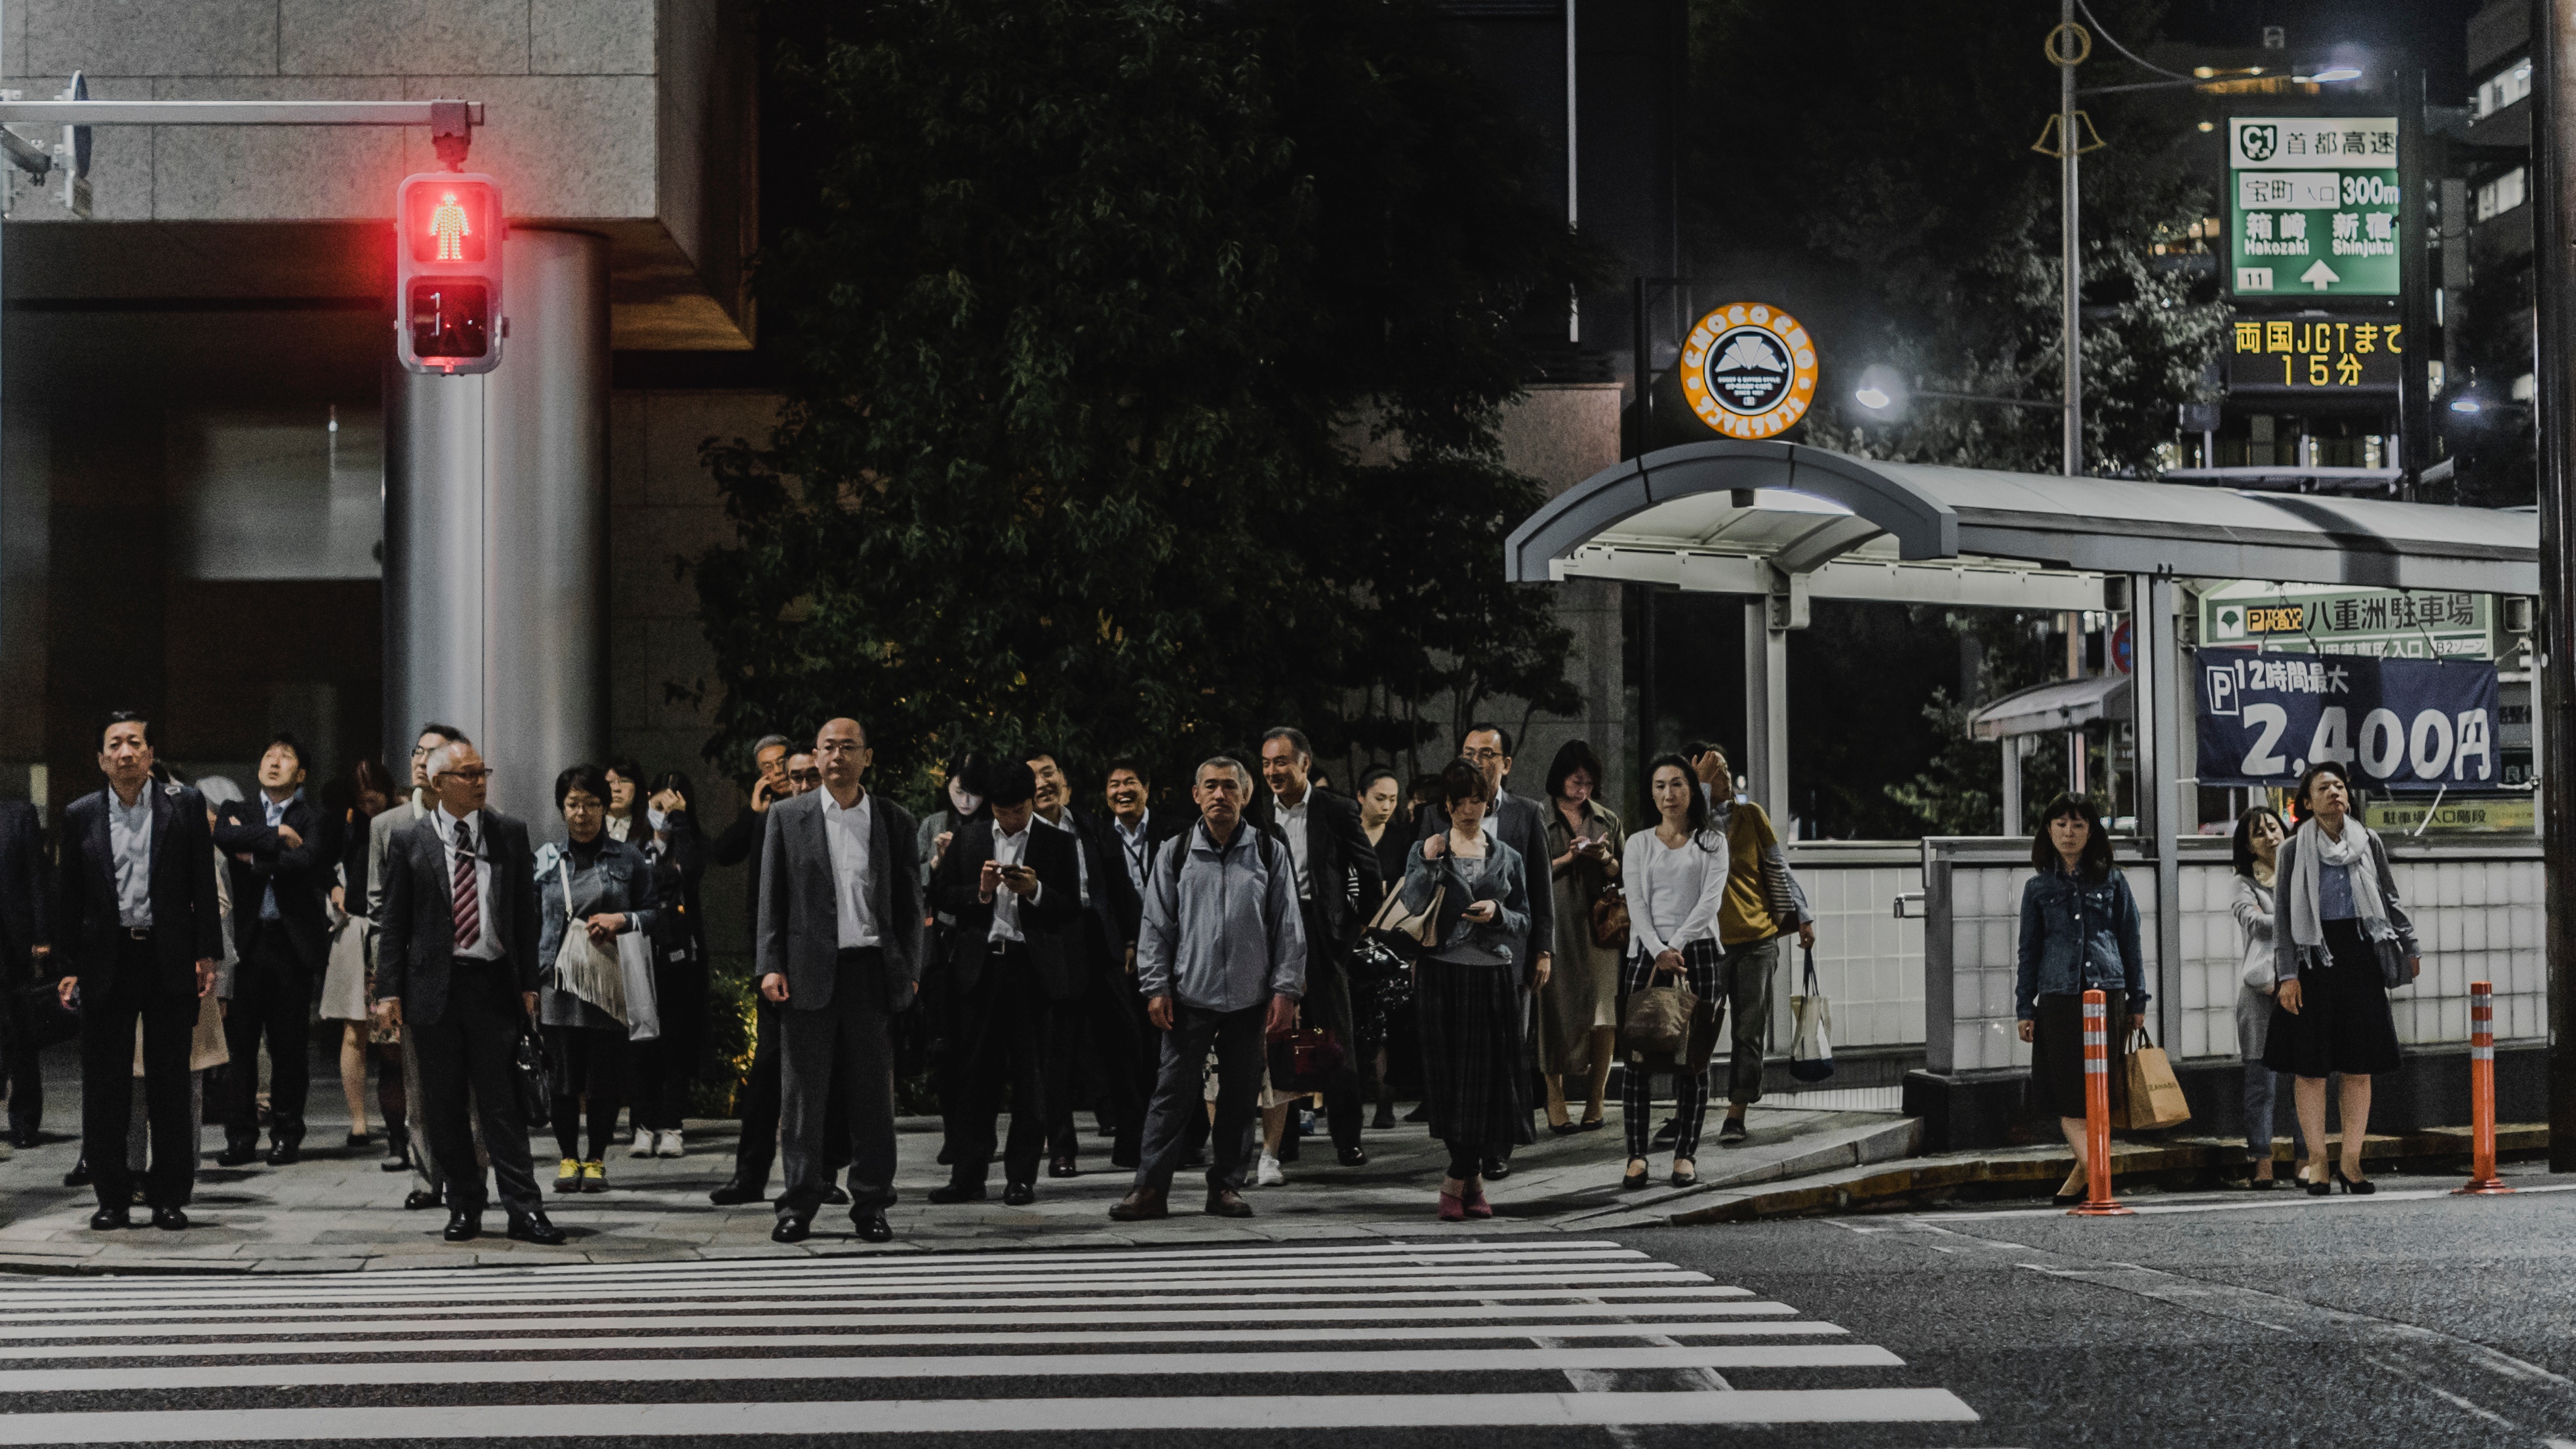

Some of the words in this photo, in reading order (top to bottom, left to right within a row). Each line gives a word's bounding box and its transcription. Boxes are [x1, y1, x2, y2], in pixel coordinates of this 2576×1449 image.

[2242, 126, 2274, 150] C1
[2286, 131, 2396, 155] 首都高速
[2246, 180, 2294, 203] 宝町
[2342, 176, 2400, 205] 300m
[2246, 212, 2307, 239] 箱崎
[2332, 211, 2393, 240] 新宿
[2244, 239, 2309, 255] Hakozaki
[2332, 239, 2394, 258] Shinjuku
[2246, 273, 2263, 286] 11
[2249, 612, 2261, 629] P
[2265, 608, 2303, 621] TOKYO
[2307, 593, 2474, 632] 八重洲駐車場
[2265, 620, 2303, 631] PUBLIC
[2234, 658, 2349, 694] 12時間最大
[2213, 671, 2232, 709] P
[2241, 703, 2491, 781] 2,400円
